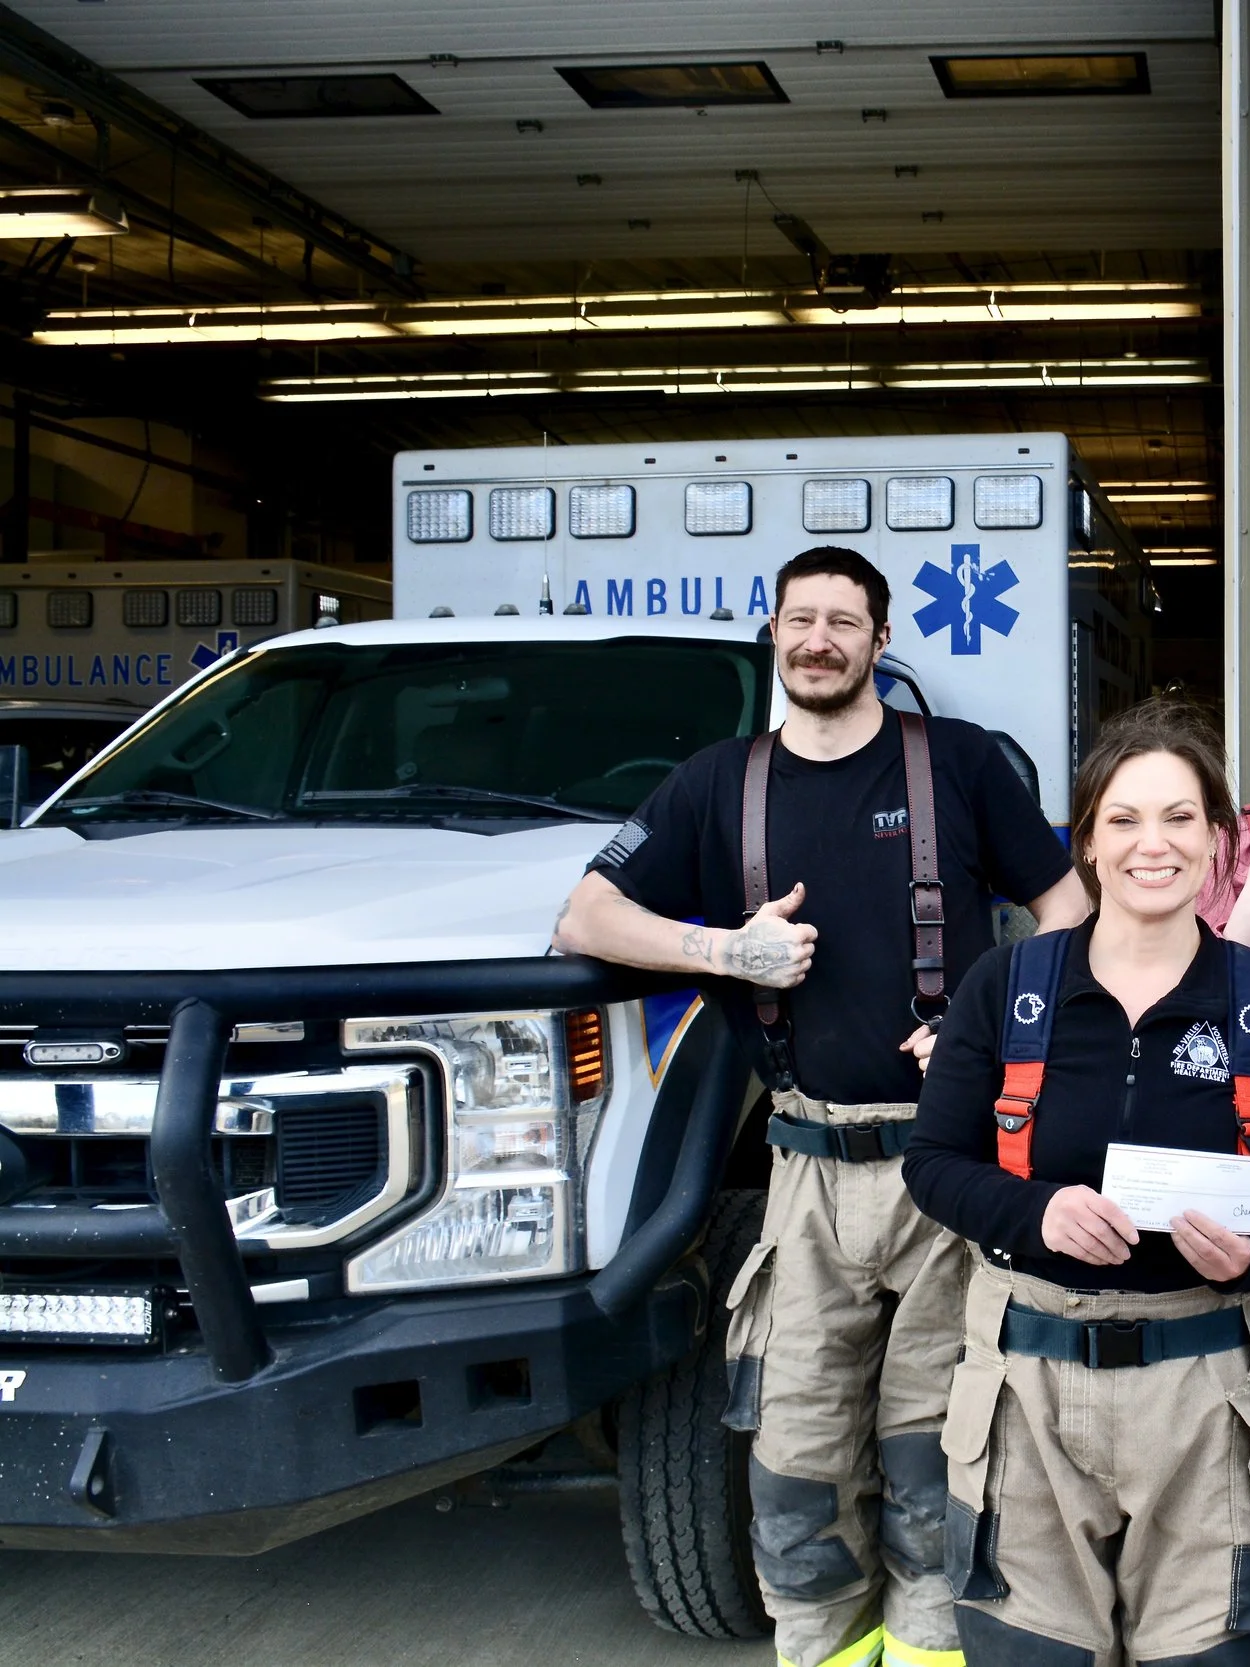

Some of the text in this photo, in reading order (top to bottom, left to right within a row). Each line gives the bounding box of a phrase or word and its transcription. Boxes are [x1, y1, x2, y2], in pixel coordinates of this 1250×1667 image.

[1172, 1021, 1201, 1056] TRI-VALLEY
[1170, 1061, 1230, 1079] FIRE DEPARTMENT
[1199, 1073, 1226, 1083] ALASKA
